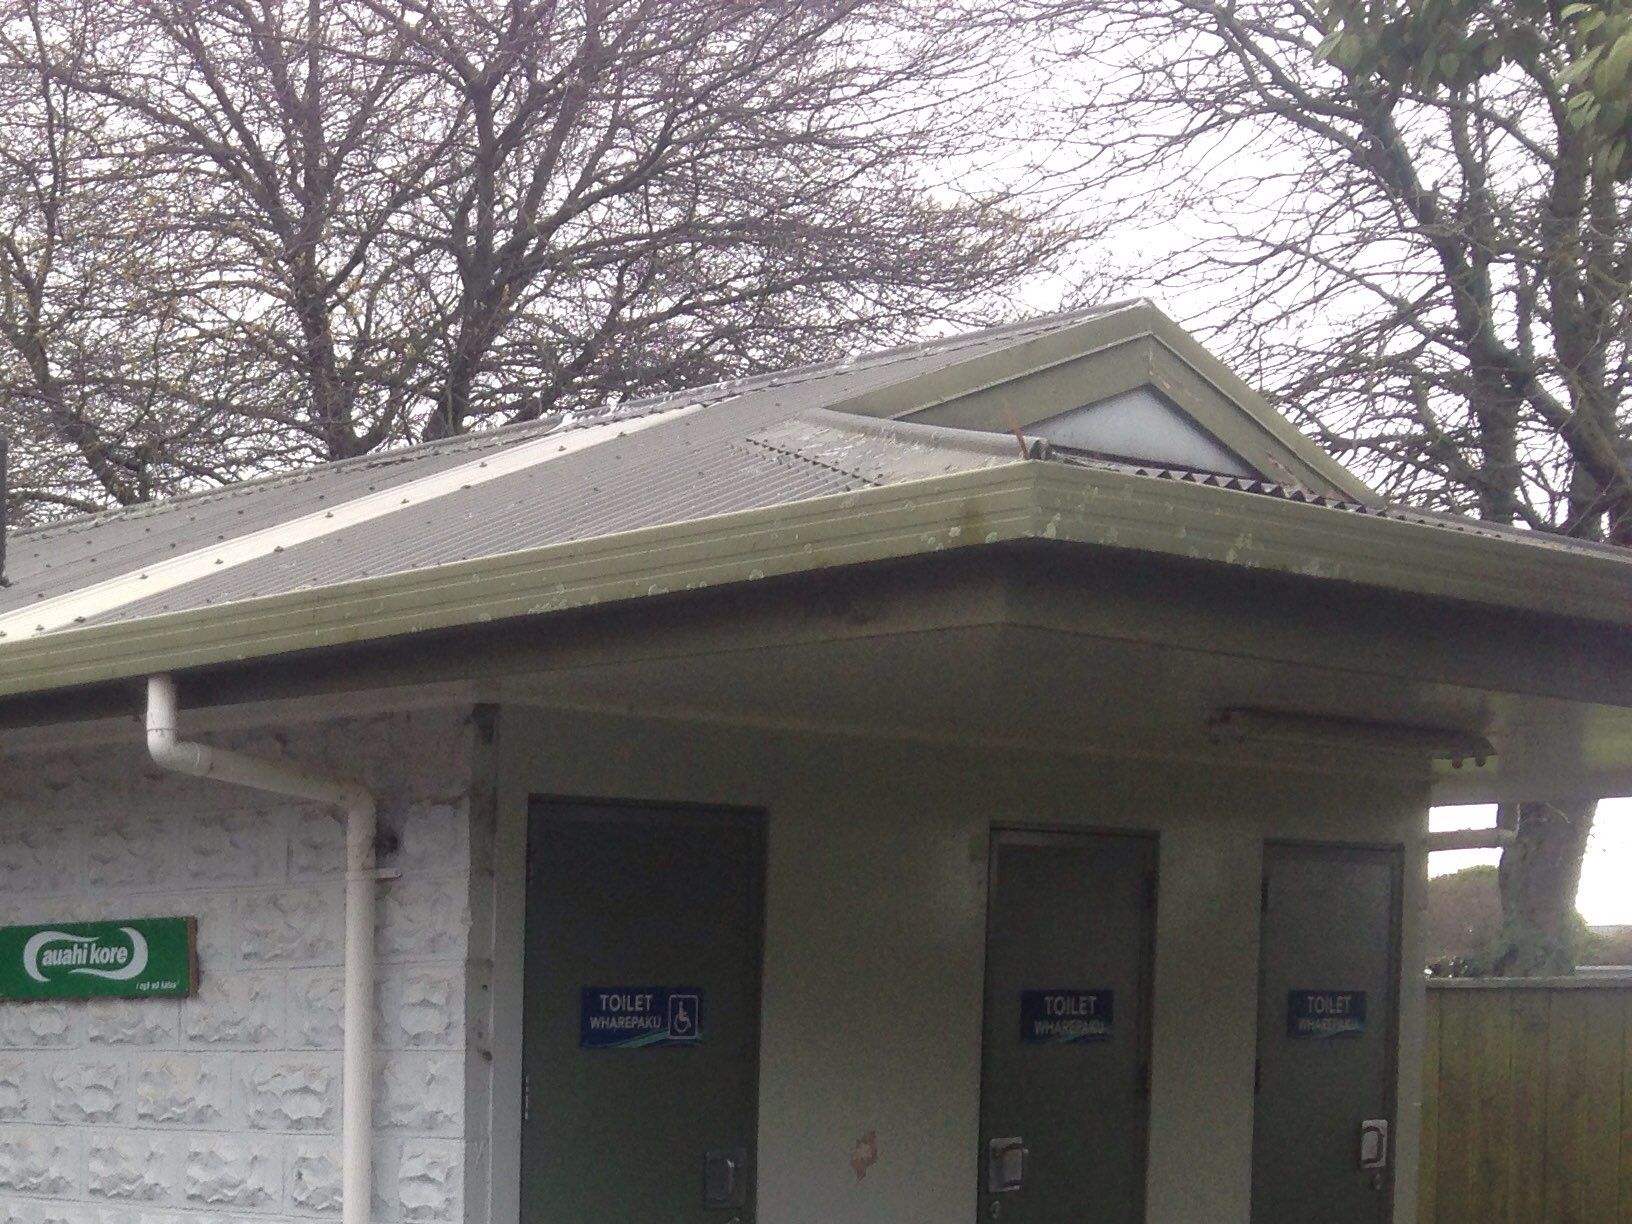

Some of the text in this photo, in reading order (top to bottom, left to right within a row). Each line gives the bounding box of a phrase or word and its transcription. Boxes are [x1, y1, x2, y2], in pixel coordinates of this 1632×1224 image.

[42, 942, 128, 966] auahi kore
[599, 994, 653, 1012] TOILET
[1044, 996, 1097, 1015] TOILET
[1307, 995, 1353, 1014] TOILET
[590, 1015, 662, 1030] WHAREPAKU
